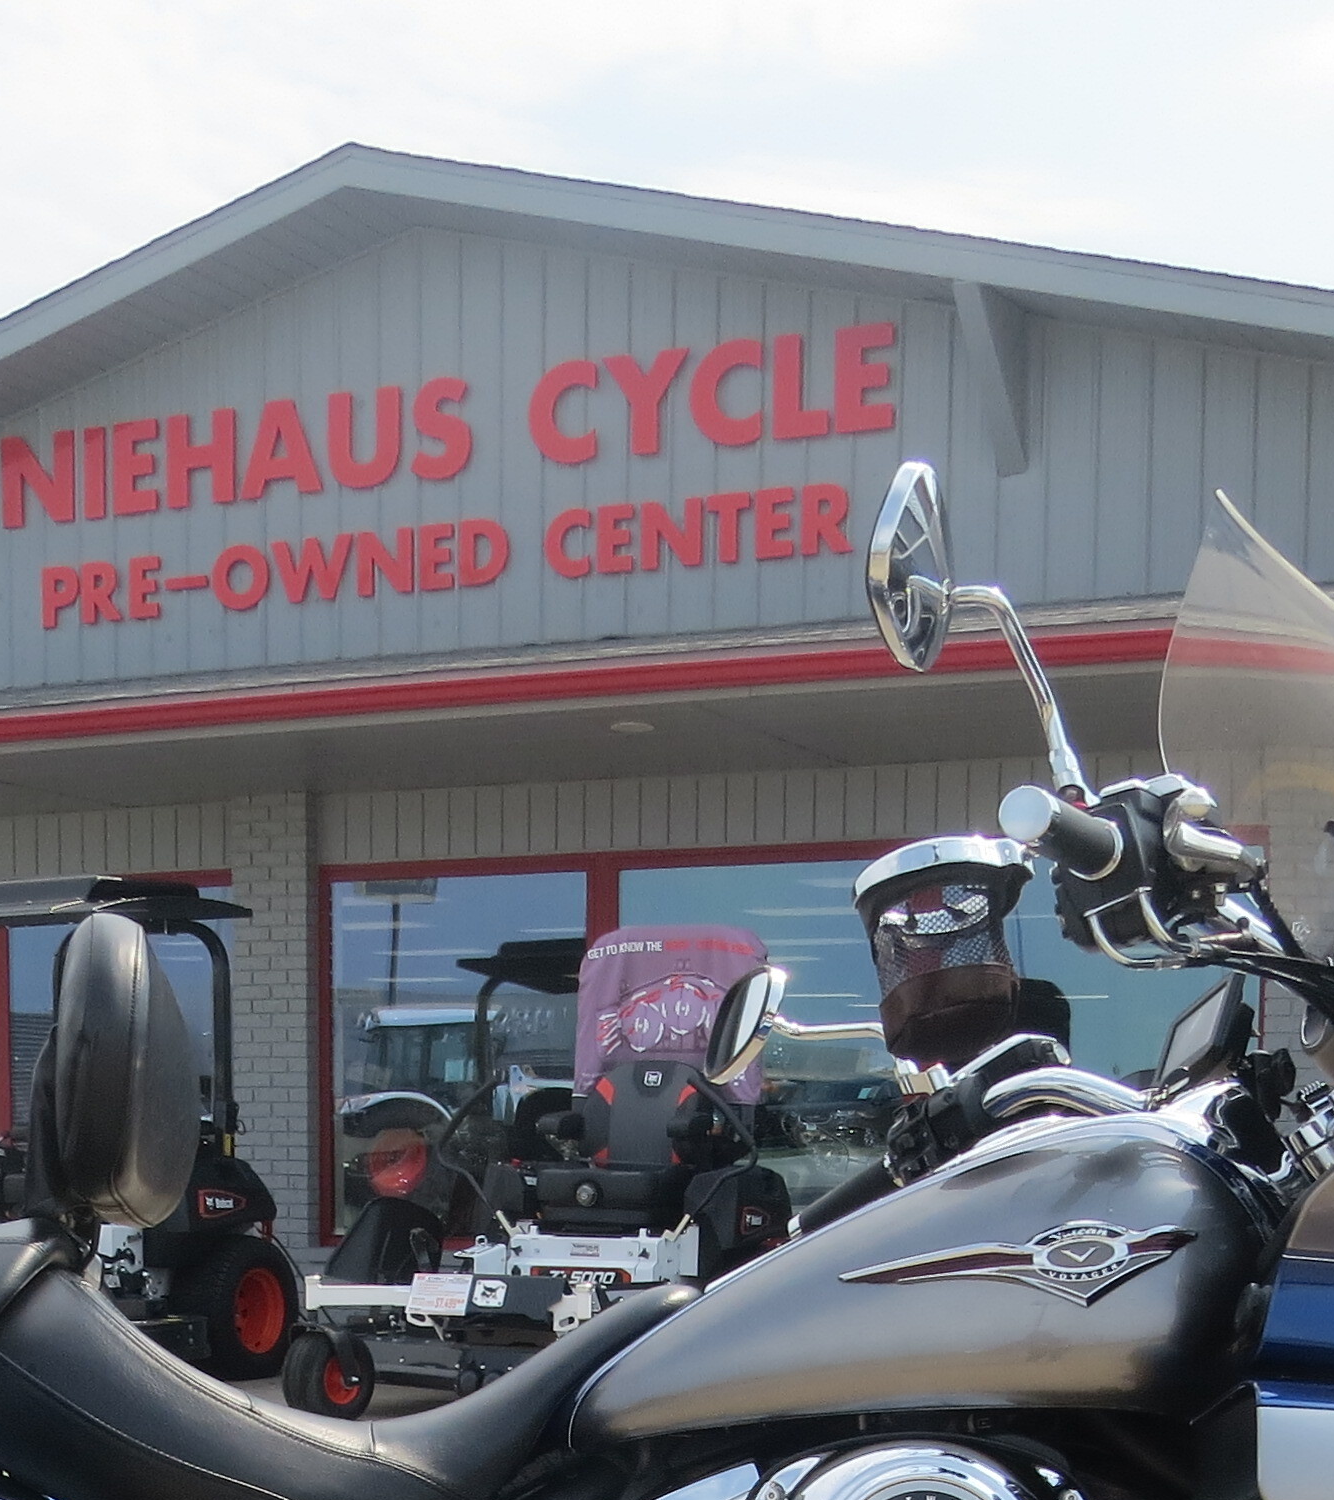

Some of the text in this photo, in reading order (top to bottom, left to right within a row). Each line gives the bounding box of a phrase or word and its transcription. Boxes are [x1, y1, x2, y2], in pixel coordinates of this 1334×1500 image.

[0, 321, 897, 530] NIEHAUS CYCLE
[40, 482, 854, 630] PRE-OWNED CENTER
[586, 946, 605, 961] GET
[605, 944, 618, 956] TO
[618, 941, 644, 954] KNOW
[645, 940, 663, 953] THE
[1049, 1262, 1119, 1281] VOYAGER
